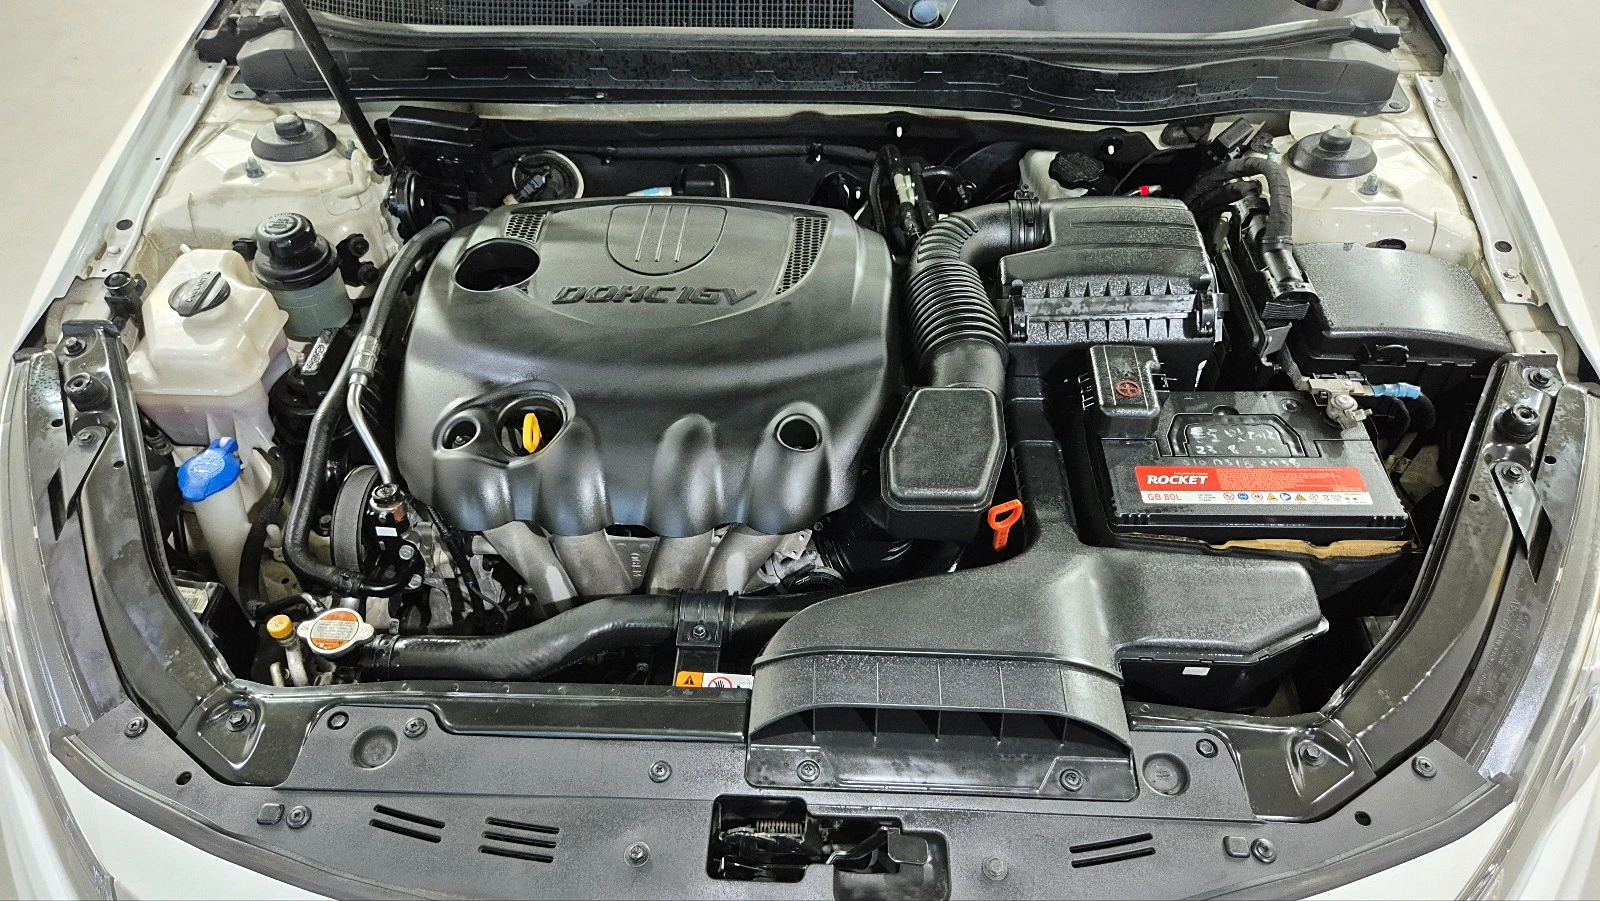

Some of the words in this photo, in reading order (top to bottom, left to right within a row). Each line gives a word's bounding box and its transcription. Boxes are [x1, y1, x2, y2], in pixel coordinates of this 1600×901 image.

[551, 285, 677, 305] DOHC
[676, 285, 758, 306] 16V
[1146, 475, 1209, 485] ROCKET
[1147, 493, 1162, 501] GB
[1164, 493, 1182, 501] 80L
